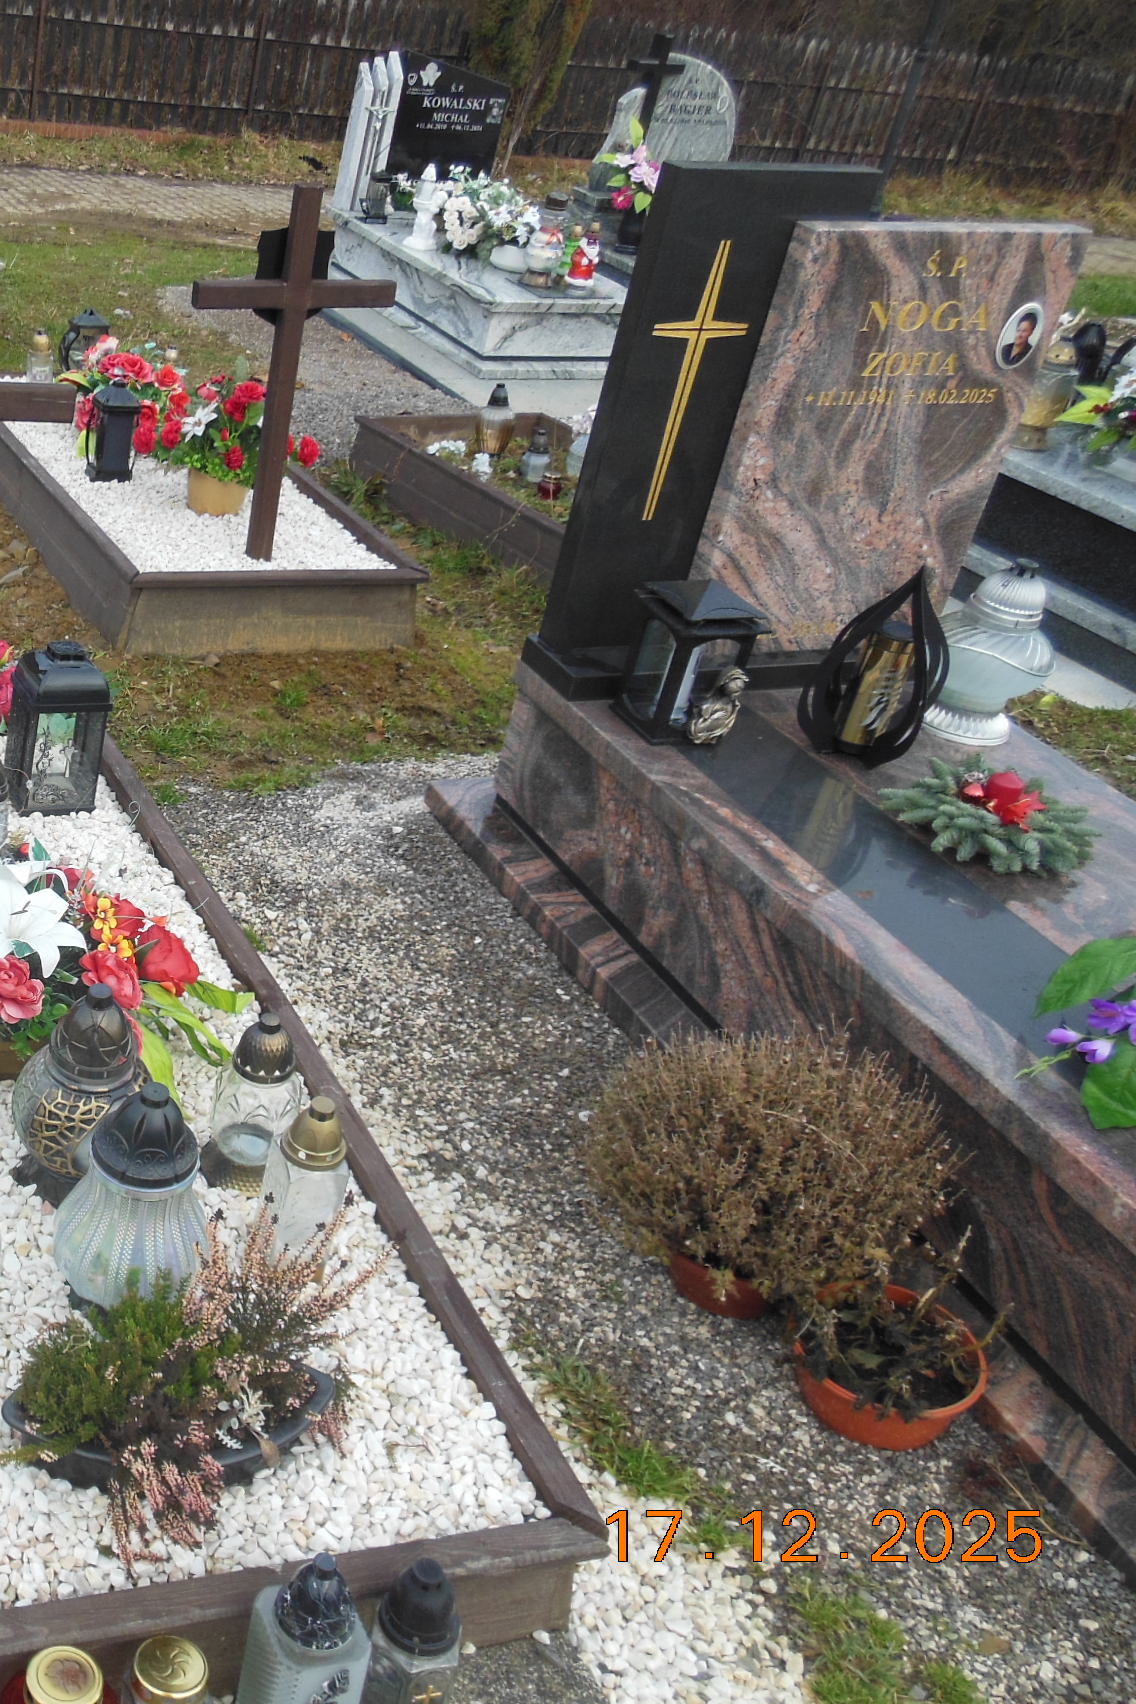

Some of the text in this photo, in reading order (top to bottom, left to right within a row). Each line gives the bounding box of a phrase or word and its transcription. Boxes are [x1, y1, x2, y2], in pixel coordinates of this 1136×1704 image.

[422, 96, 486, 110] KOWALSKI
[860, 300, 990, 332] NOGA
[860, 352, 958, 377] ZOFIA
[919, 388, 999, 405] 18.02.2025
